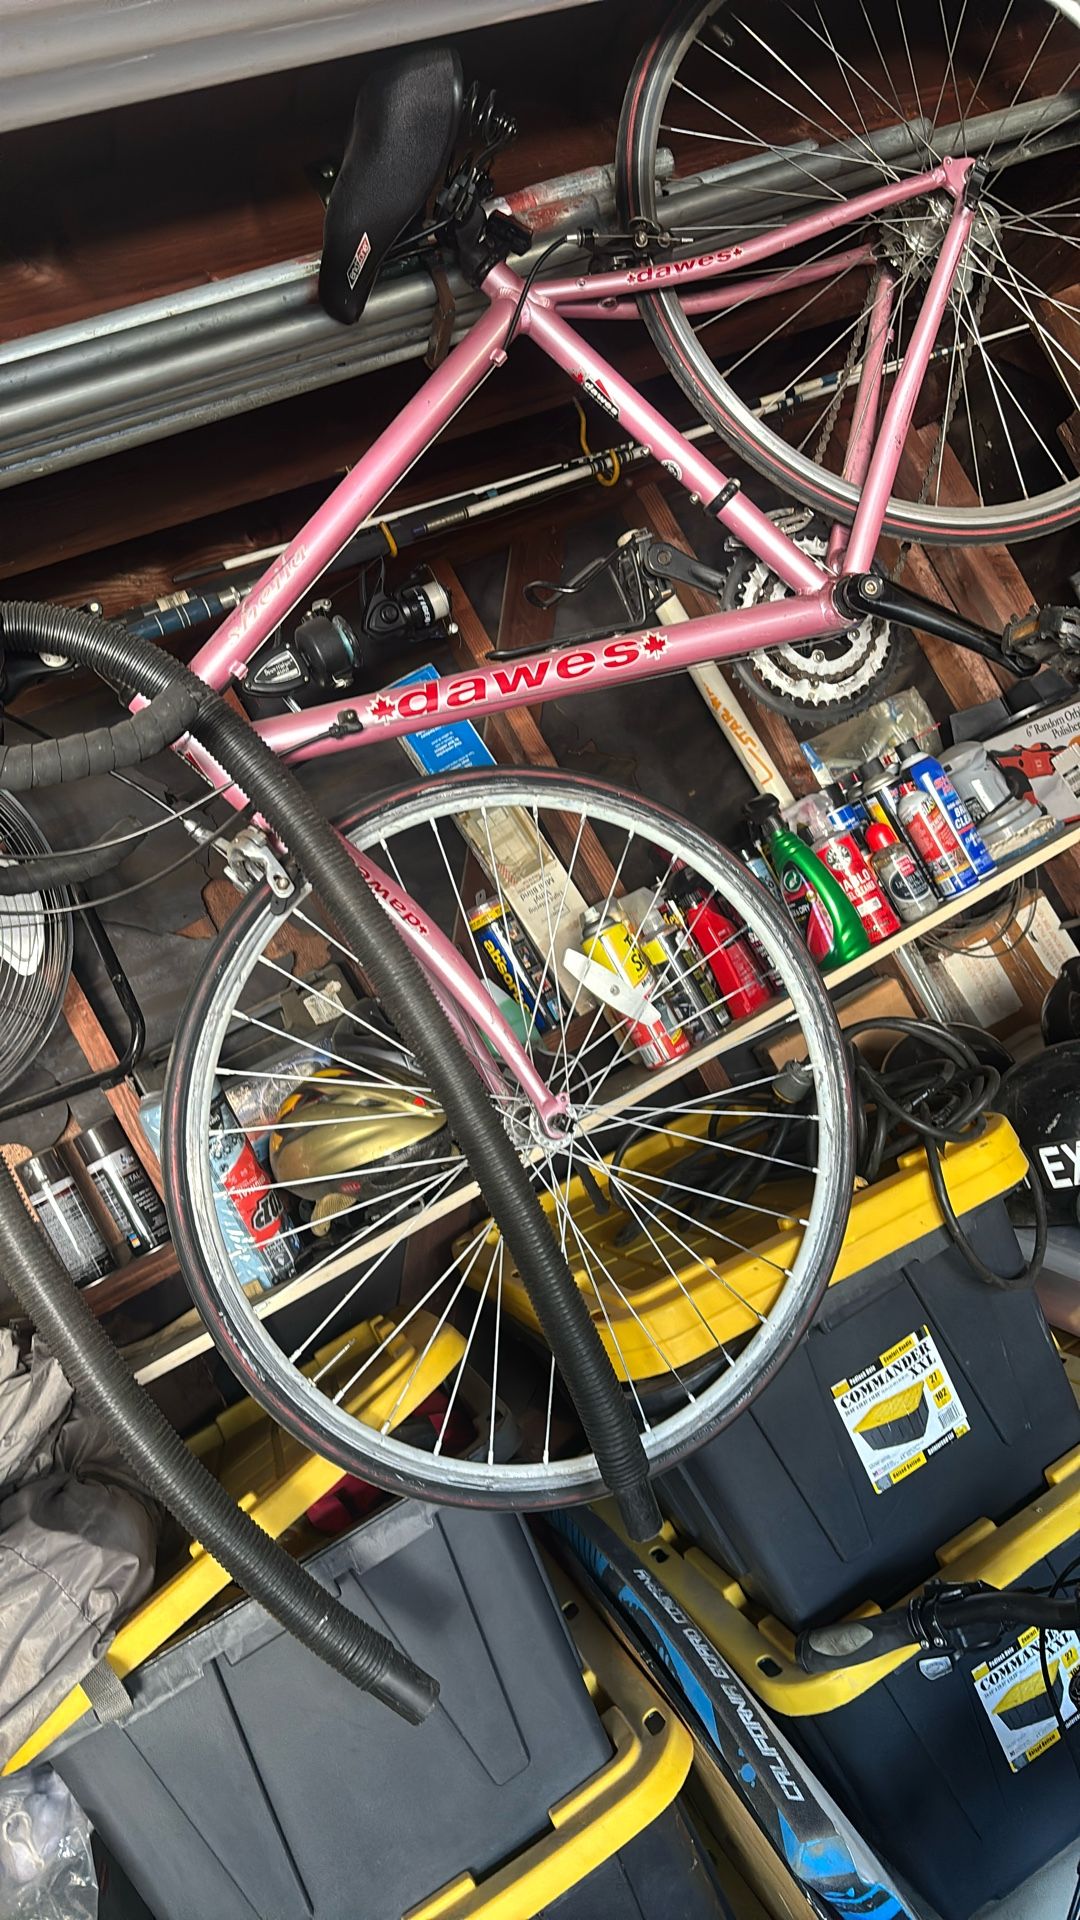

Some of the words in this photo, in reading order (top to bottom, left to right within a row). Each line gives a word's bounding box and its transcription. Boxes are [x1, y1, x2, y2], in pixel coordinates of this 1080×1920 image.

[637, 250, 732, 282] dawes
[585, 381, 618, 416] dawes
[397, 638, 642, 719] dawes
[721, 707, 756, 747] STAR
[1034, 715, 1063, 736] Random
[520, 886, 539, 901] Blind
[839, 1341, 931, 1410] COMMANDER
[908, 1353, 937, 1380] XXL
[928, 1372, 938, 1384] 27
[934, 1388, 948, 1402] 102
[683, 1628, 730, 1680] BOARD
[1064, 1650, 1074, 1662] 27
[721, 1682, 805, 1801] CALIFORNIA
